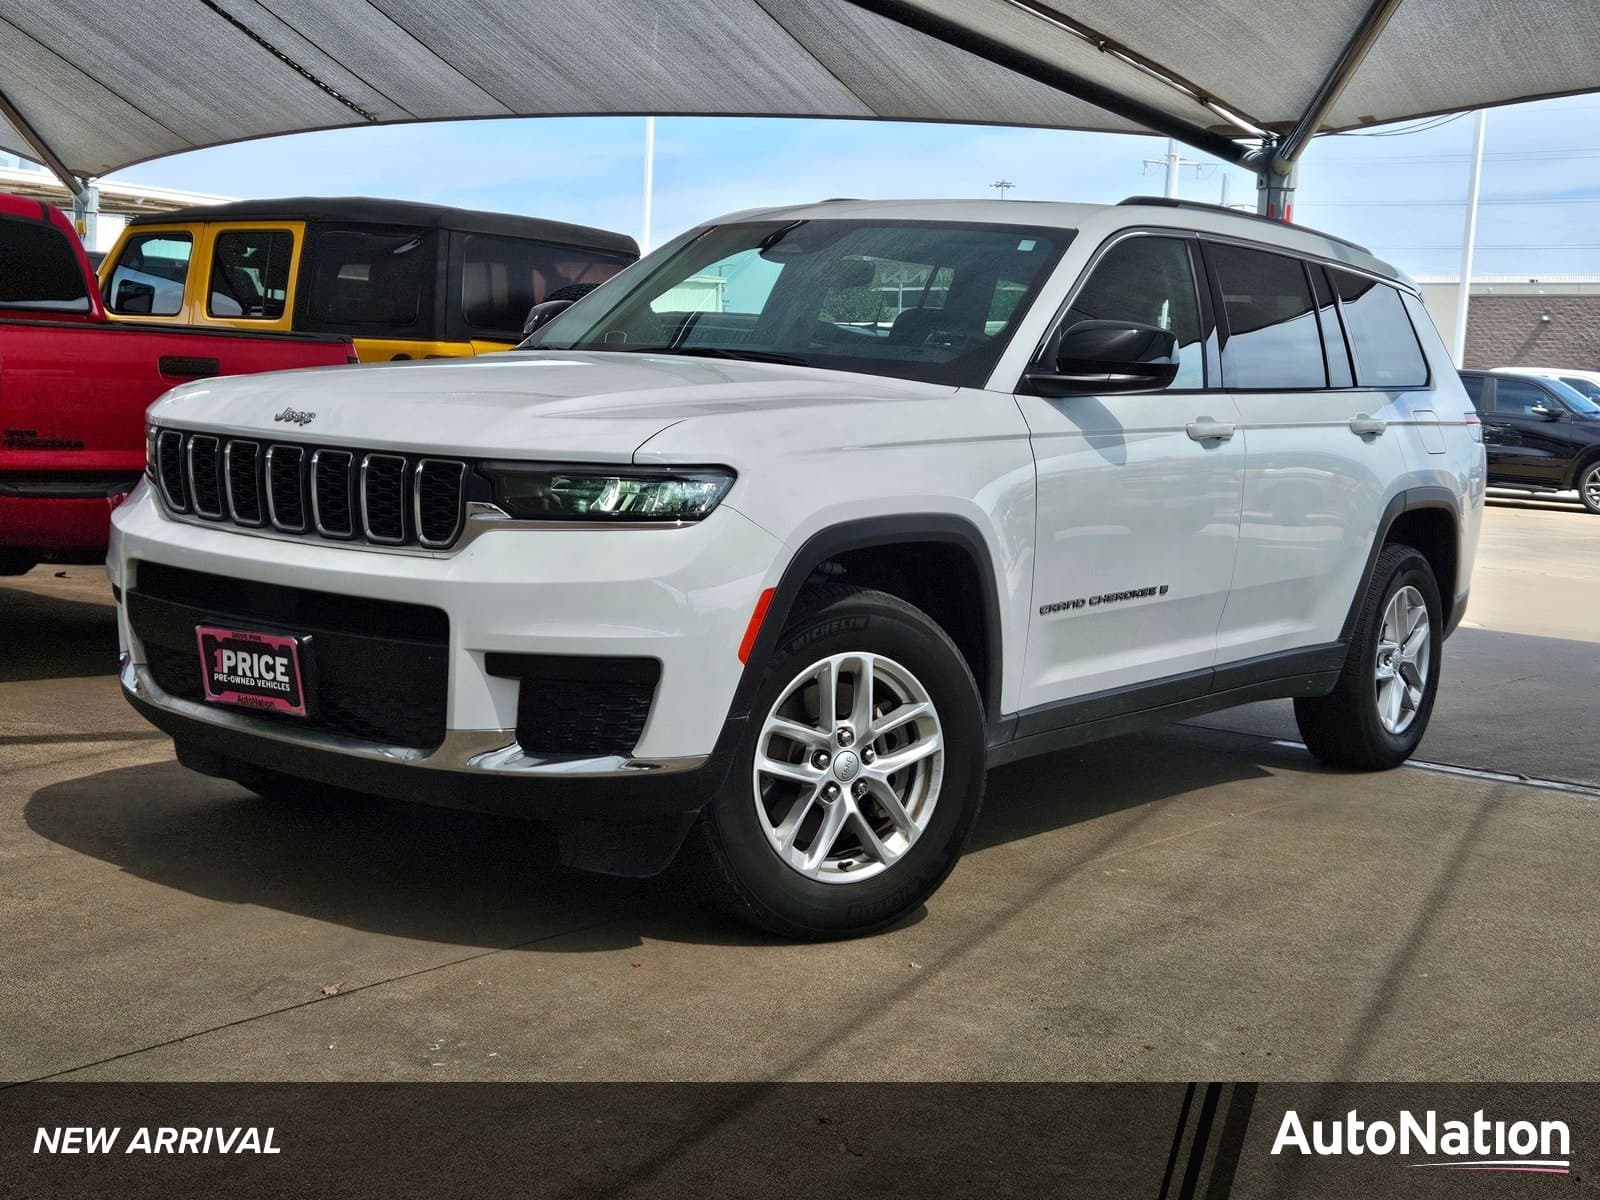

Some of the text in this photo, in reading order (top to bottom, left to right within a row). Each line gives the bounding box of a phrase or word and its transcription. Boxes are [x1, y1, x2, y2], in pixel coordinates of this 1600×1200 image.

[274, 407, 316, 427] Jeep
[1040, 599, 1087, 616] GRAND
[1088, 586, 1157, 606] CHEROKEE
[214, 673, 291, 692] PRE-OWNED VEHICLES
